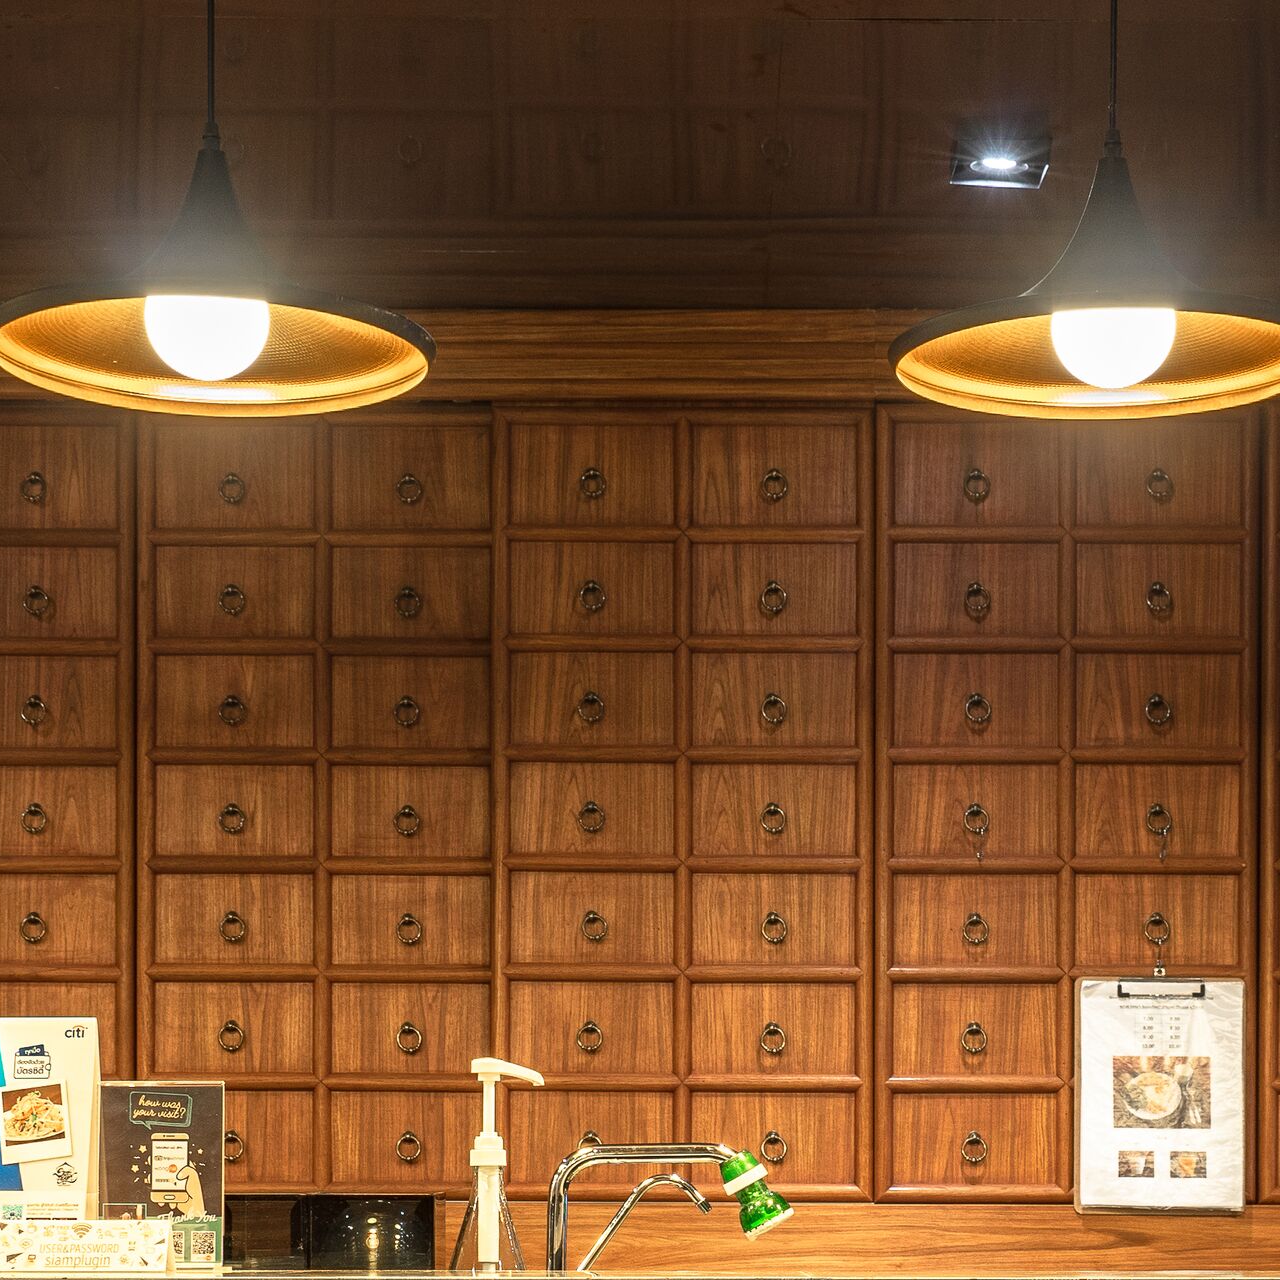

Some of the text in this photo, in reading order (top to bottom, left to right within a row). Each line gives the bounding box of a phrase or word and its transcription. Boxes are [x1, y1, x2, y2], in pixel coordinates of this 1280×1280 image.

[64, 1025, 86, 1038] citi
[138, 1094, 181, 1110] how was
[132, 1107, 186, 1119] your visit?
[196, 1211, 218, 1223] You
[39, 1243, 120, 1254] USER&PASSWORD
[45, 1254, 111, 1269] siamplugin
